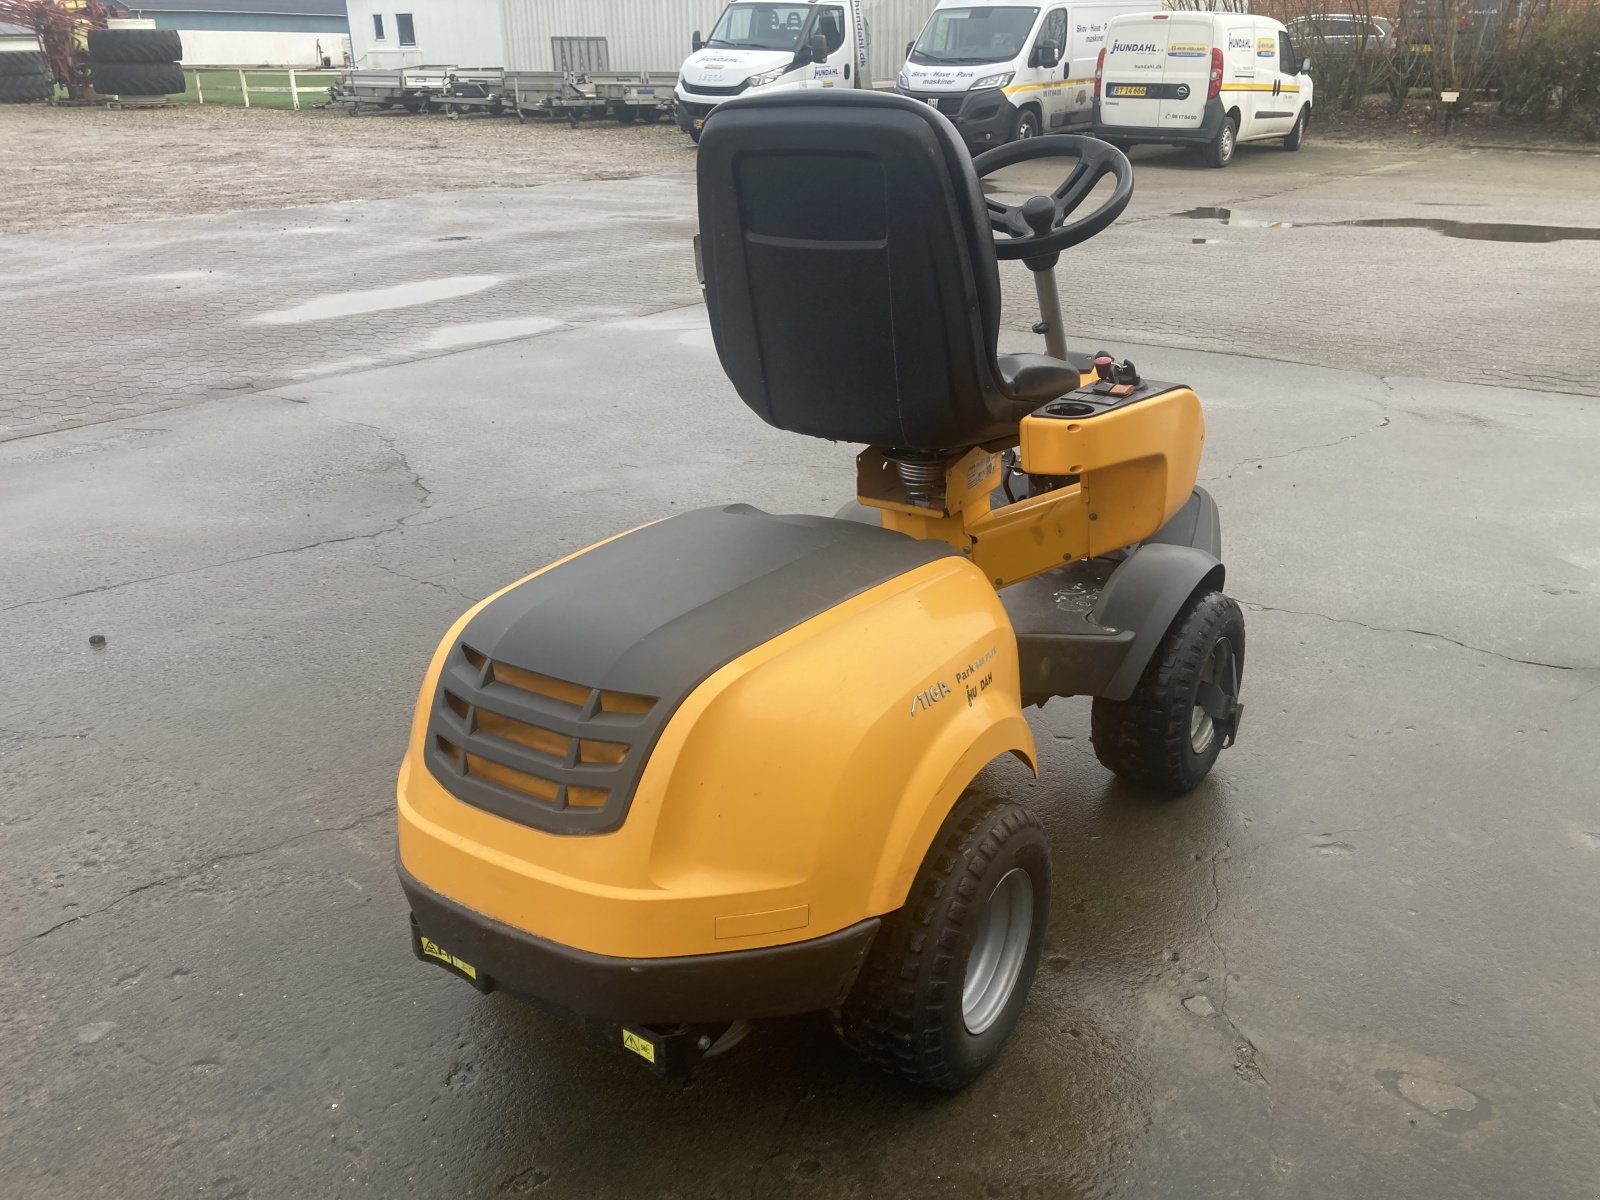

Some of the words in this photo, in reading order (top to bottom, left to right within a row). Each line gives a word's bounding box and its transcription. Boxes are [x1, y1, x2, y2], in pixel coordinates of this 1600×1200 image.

[854, 0, 867, 68] hundahl.dk
[955, 663, 976, 684] Park
[980, 672, 993, 691] DAH
